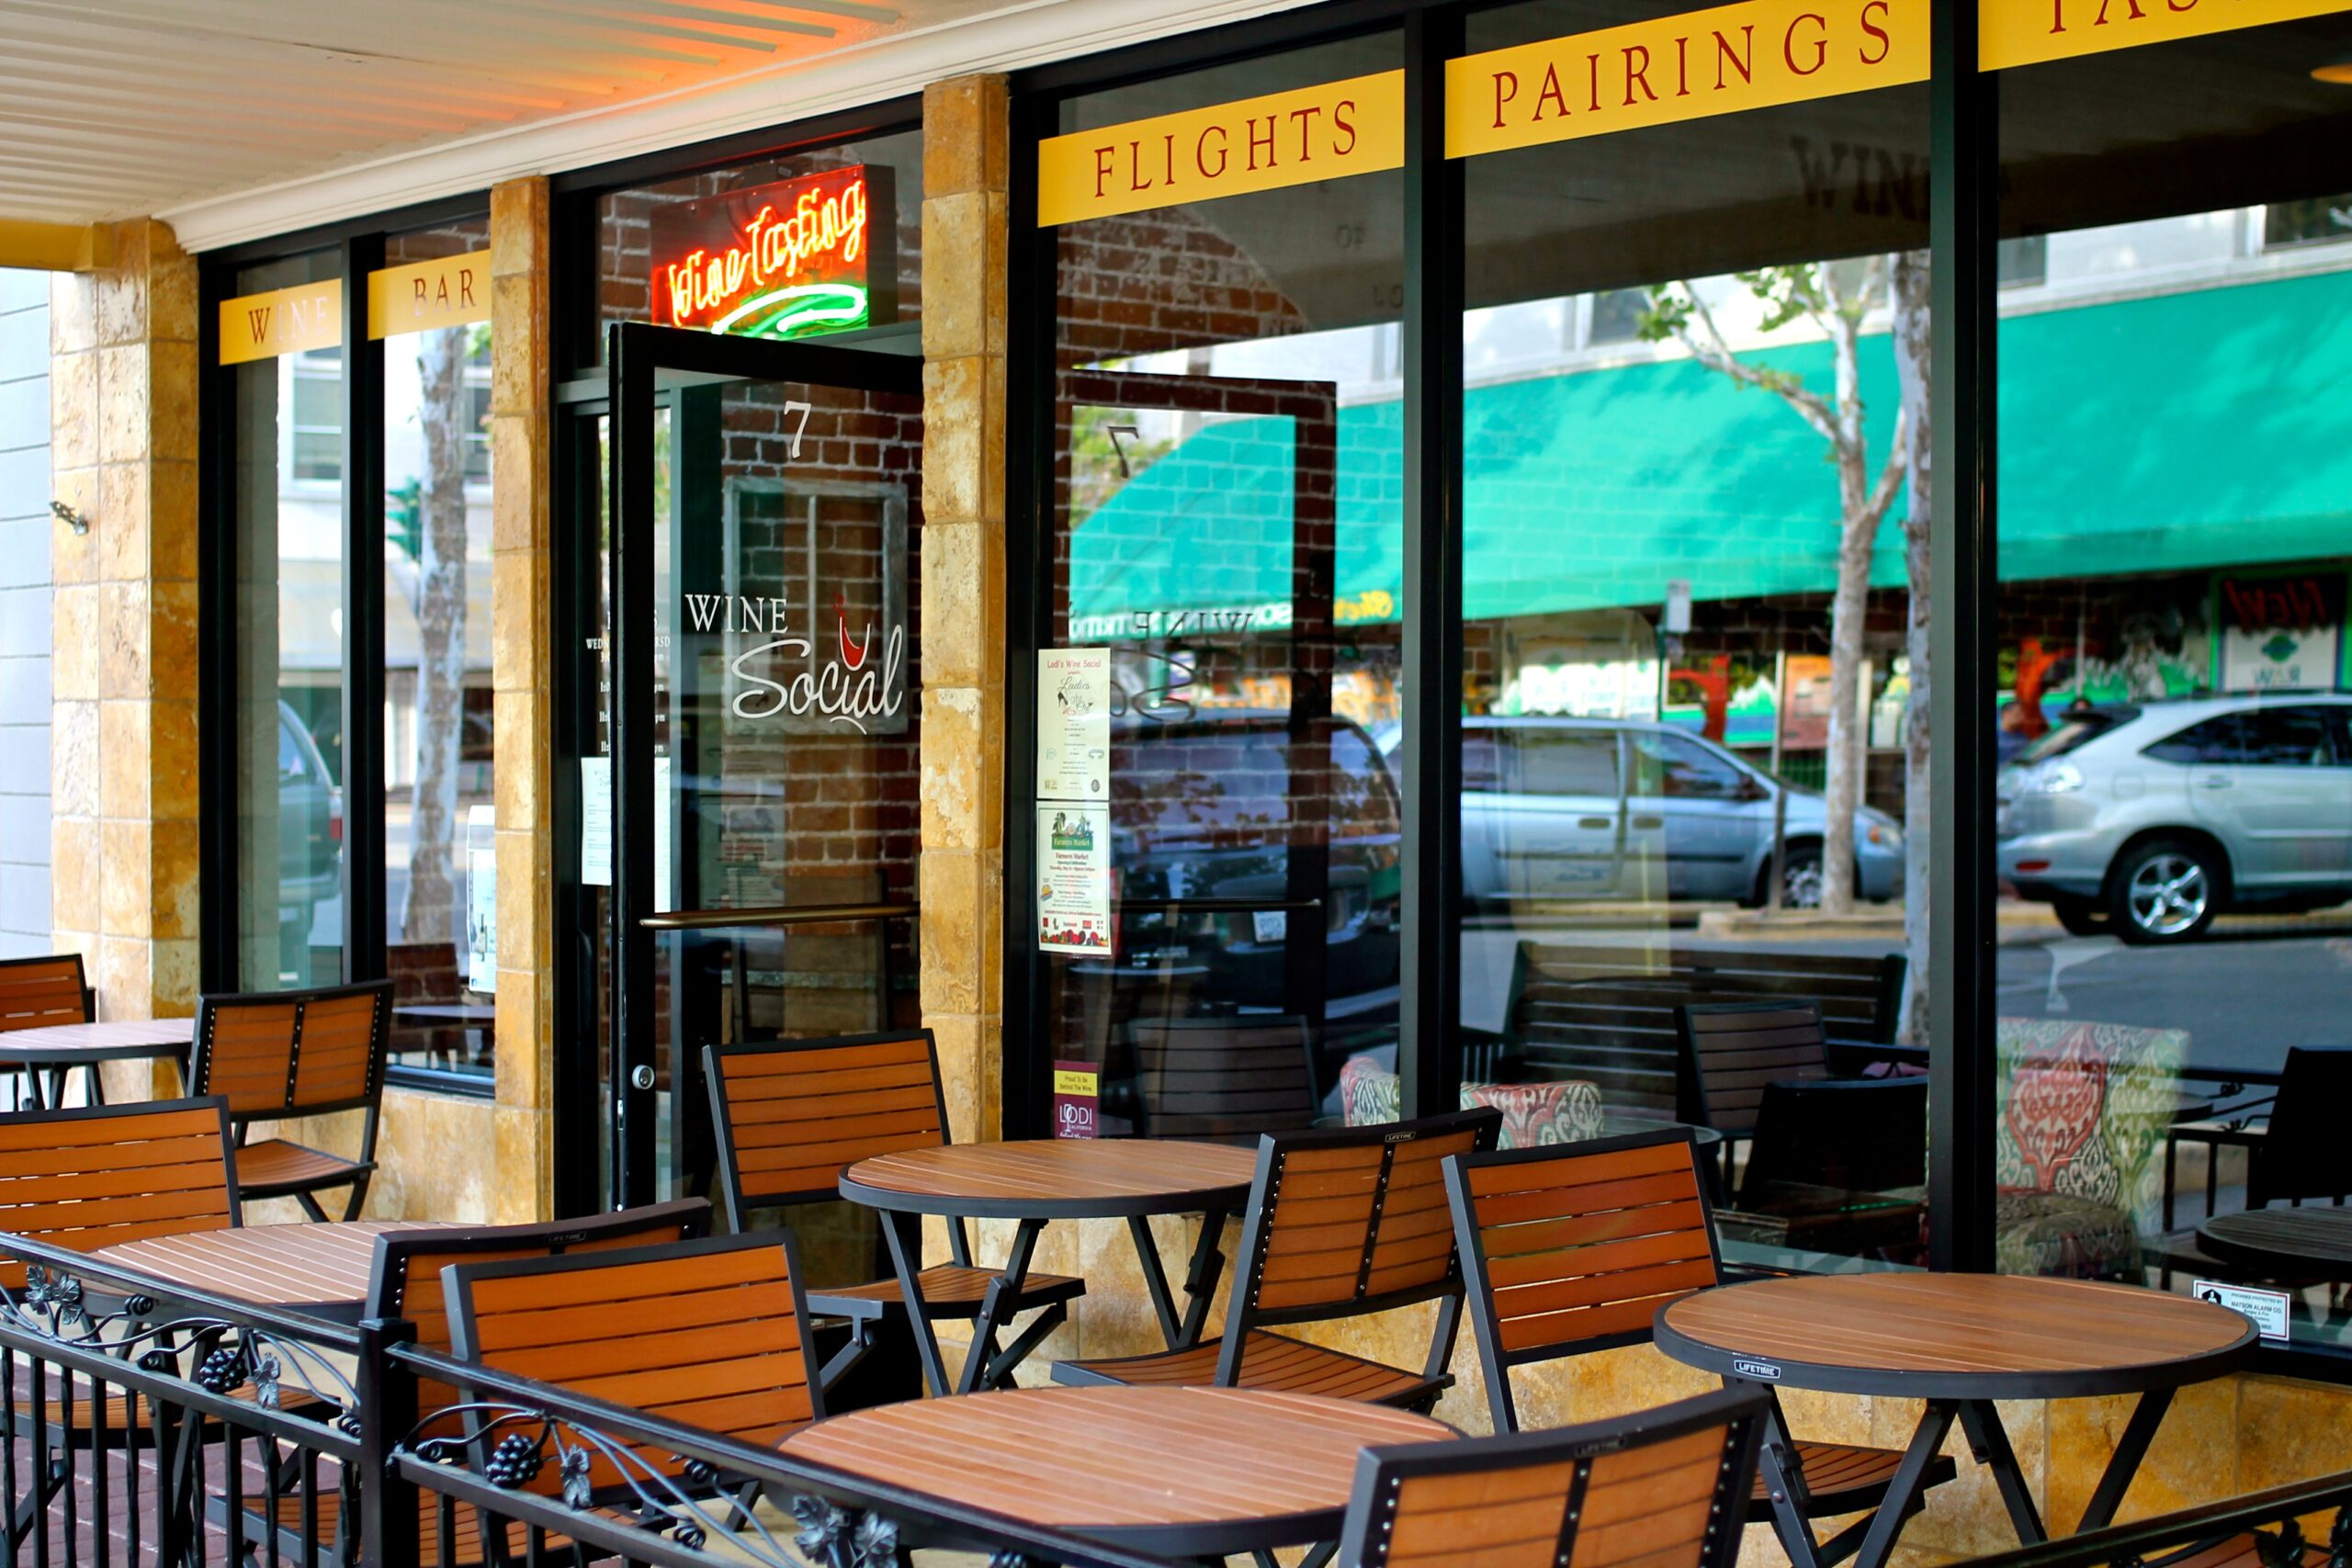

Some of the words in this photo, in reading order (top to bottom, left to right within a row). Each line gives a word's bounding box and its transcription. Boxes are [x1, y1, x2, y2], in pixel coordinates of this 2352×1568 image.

[1492, 1, 1890, 128] PAIRINGS
[1094, 100, 1356, 197] FLIGHTS
[668, 250, 752, 327] Wine
[746, 180, 866, 286] Tasting
[248, 295, 329, 345] WINE
[413, 269, 476, 317] BAR
[784, 400, 811, 458] 7
[685, 593, 788, 634] WINE
[731, 625, 903, 722] Social
[1047, 660, 1064, 669] Lodi's
[1066, 659, 1080, 669] Wine
[1083, 659, 1102, 669] Social
[1057, 676, 1091, 691] Ladies
[1065, 1074, 1076, 1082] Proud
[1059, 1104, 1092, 1125] LODI
[1739, 1362, 1775, 1376] LIFETIME
